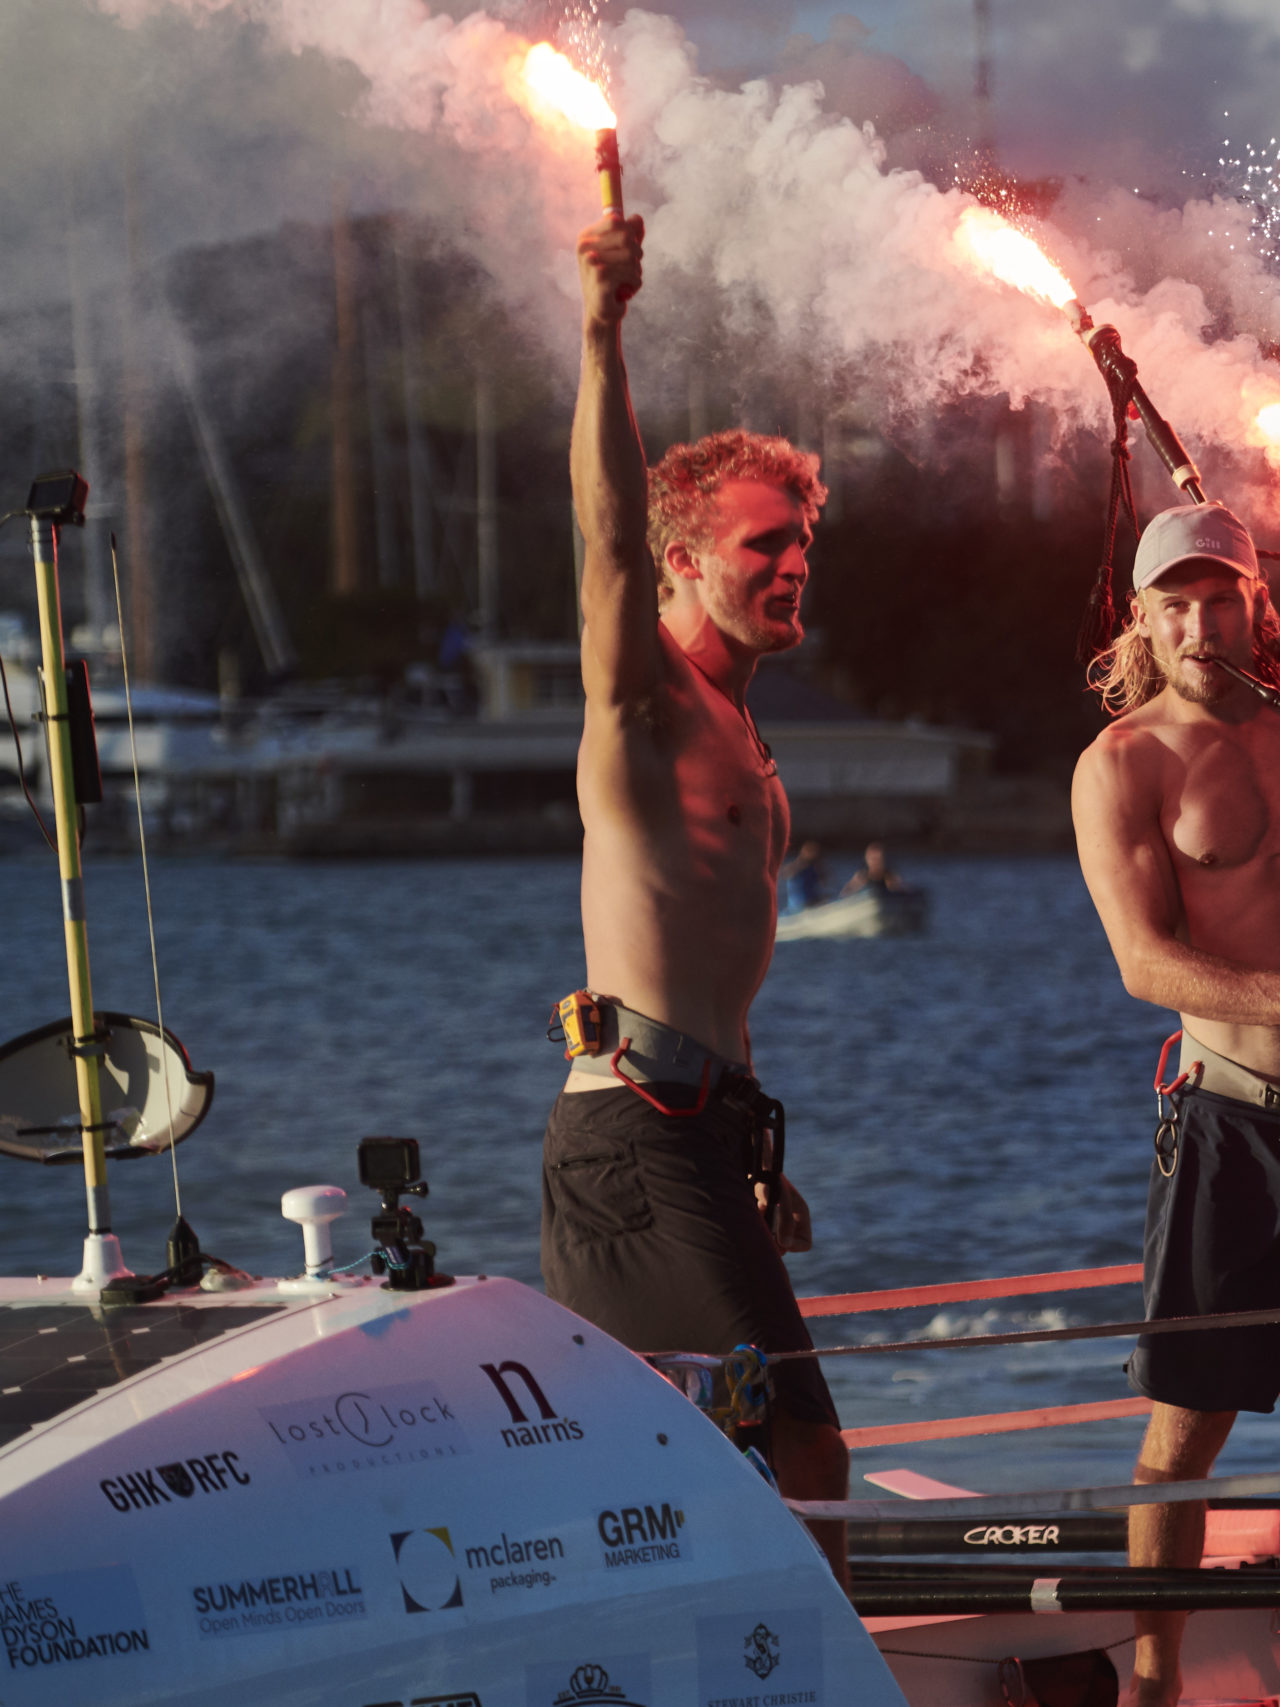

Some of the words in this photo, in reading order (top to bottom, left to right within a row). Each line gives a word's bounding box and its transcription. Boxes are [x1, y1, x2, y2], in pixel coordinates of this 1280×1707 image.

[500, 1417, 585, 1449] nairn's
[598, 1503, 678, 1547] GRM
[963, 1525, 1060, 1545] CROKER
[465, 1533, 565, 1569] mclaren
[604, 1542, 681, 1568] MARKETING
[193, 1569, 363, 1614] SUMMERHALL
[490, 1568, 552, 1595] packaging
[1, 1616, 77, 1647] DYSON
[199, 1616, 240, 1635] Open
[242, 1607, 282, 1628] Minds
[284, 1604, 322, 1624] Open
[325, 1600, 367, 1618] Doors
[8, 1628, 150, 1669] FOUNDATION
[762, 1690, 816, 1707] CHRISTIE
